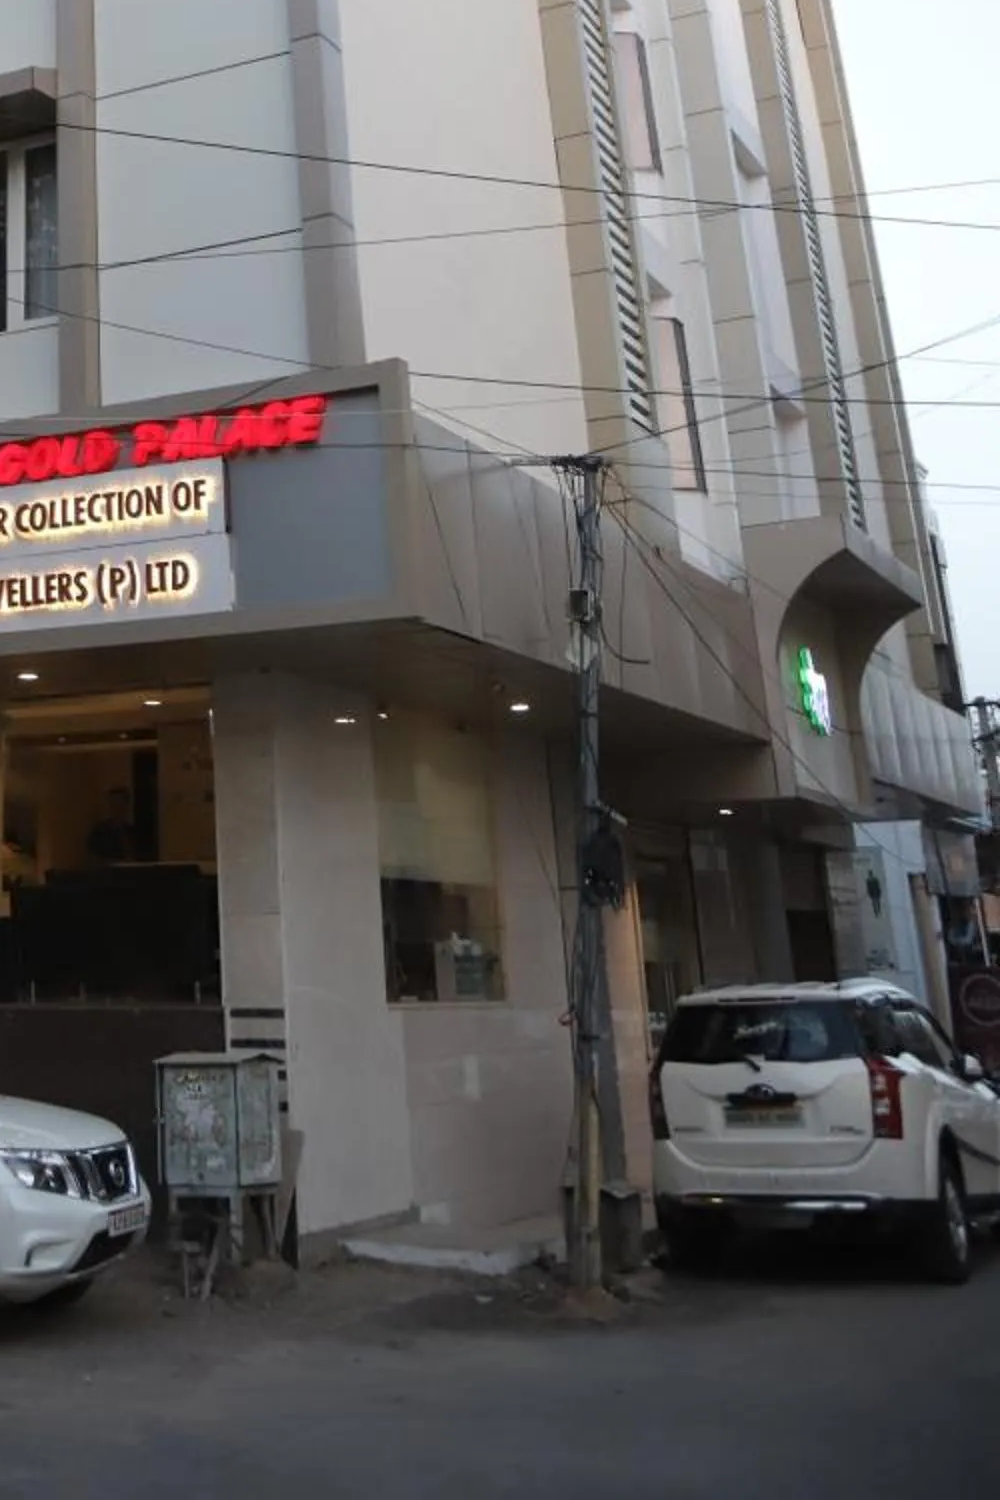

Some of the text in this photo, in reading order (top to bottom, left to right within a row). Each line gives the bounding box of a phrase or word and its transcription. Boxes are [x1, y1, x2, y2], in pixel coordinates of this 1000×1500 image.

[130, 394, 326, 467] PALACE
[15, 485, 164, 534] COLLECTION
[172, 479, 207, 512] OF
[96, 559, 137, 604] (P)
[145, 560, 190, 593] LTD
